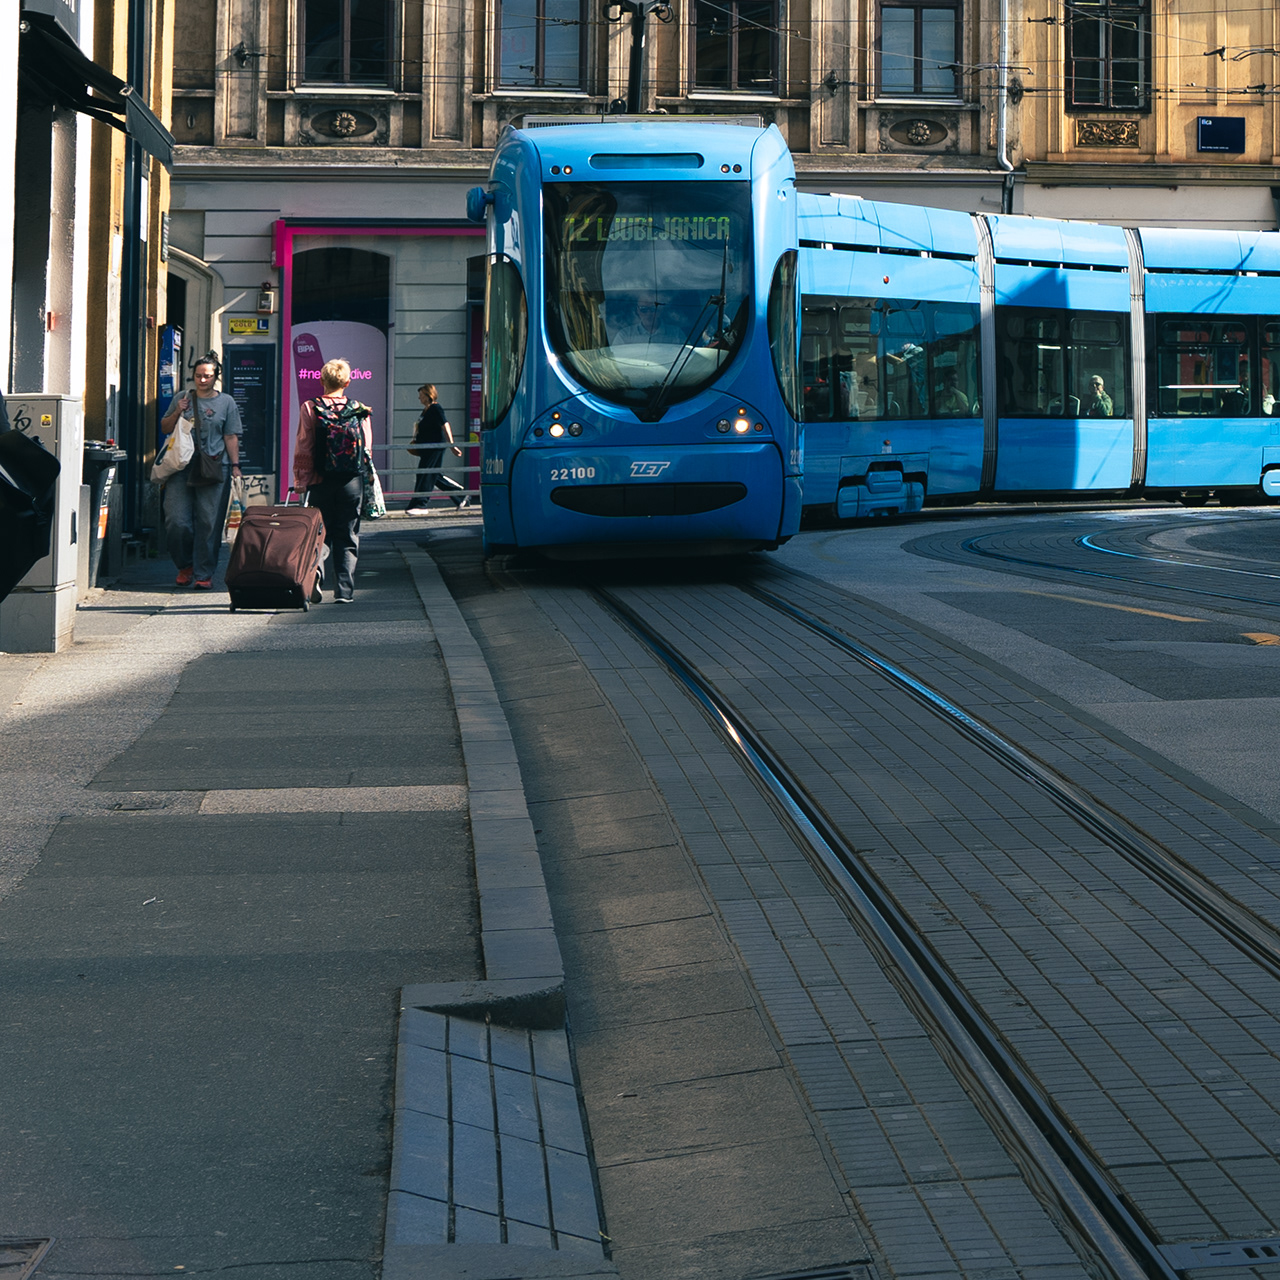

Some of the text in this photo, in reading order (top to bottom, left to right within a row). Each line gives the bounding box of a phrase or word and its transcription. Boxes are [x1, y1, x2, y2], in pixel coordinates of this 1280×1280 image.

[597, 216, 731, 242] LJUBLJANICA
[297, 344, 315, 353] BIPA
[485, 459, 504, 475] 22100
[550, 467, 596, 481] 22100
[630, 462, 671, 477] ZET
